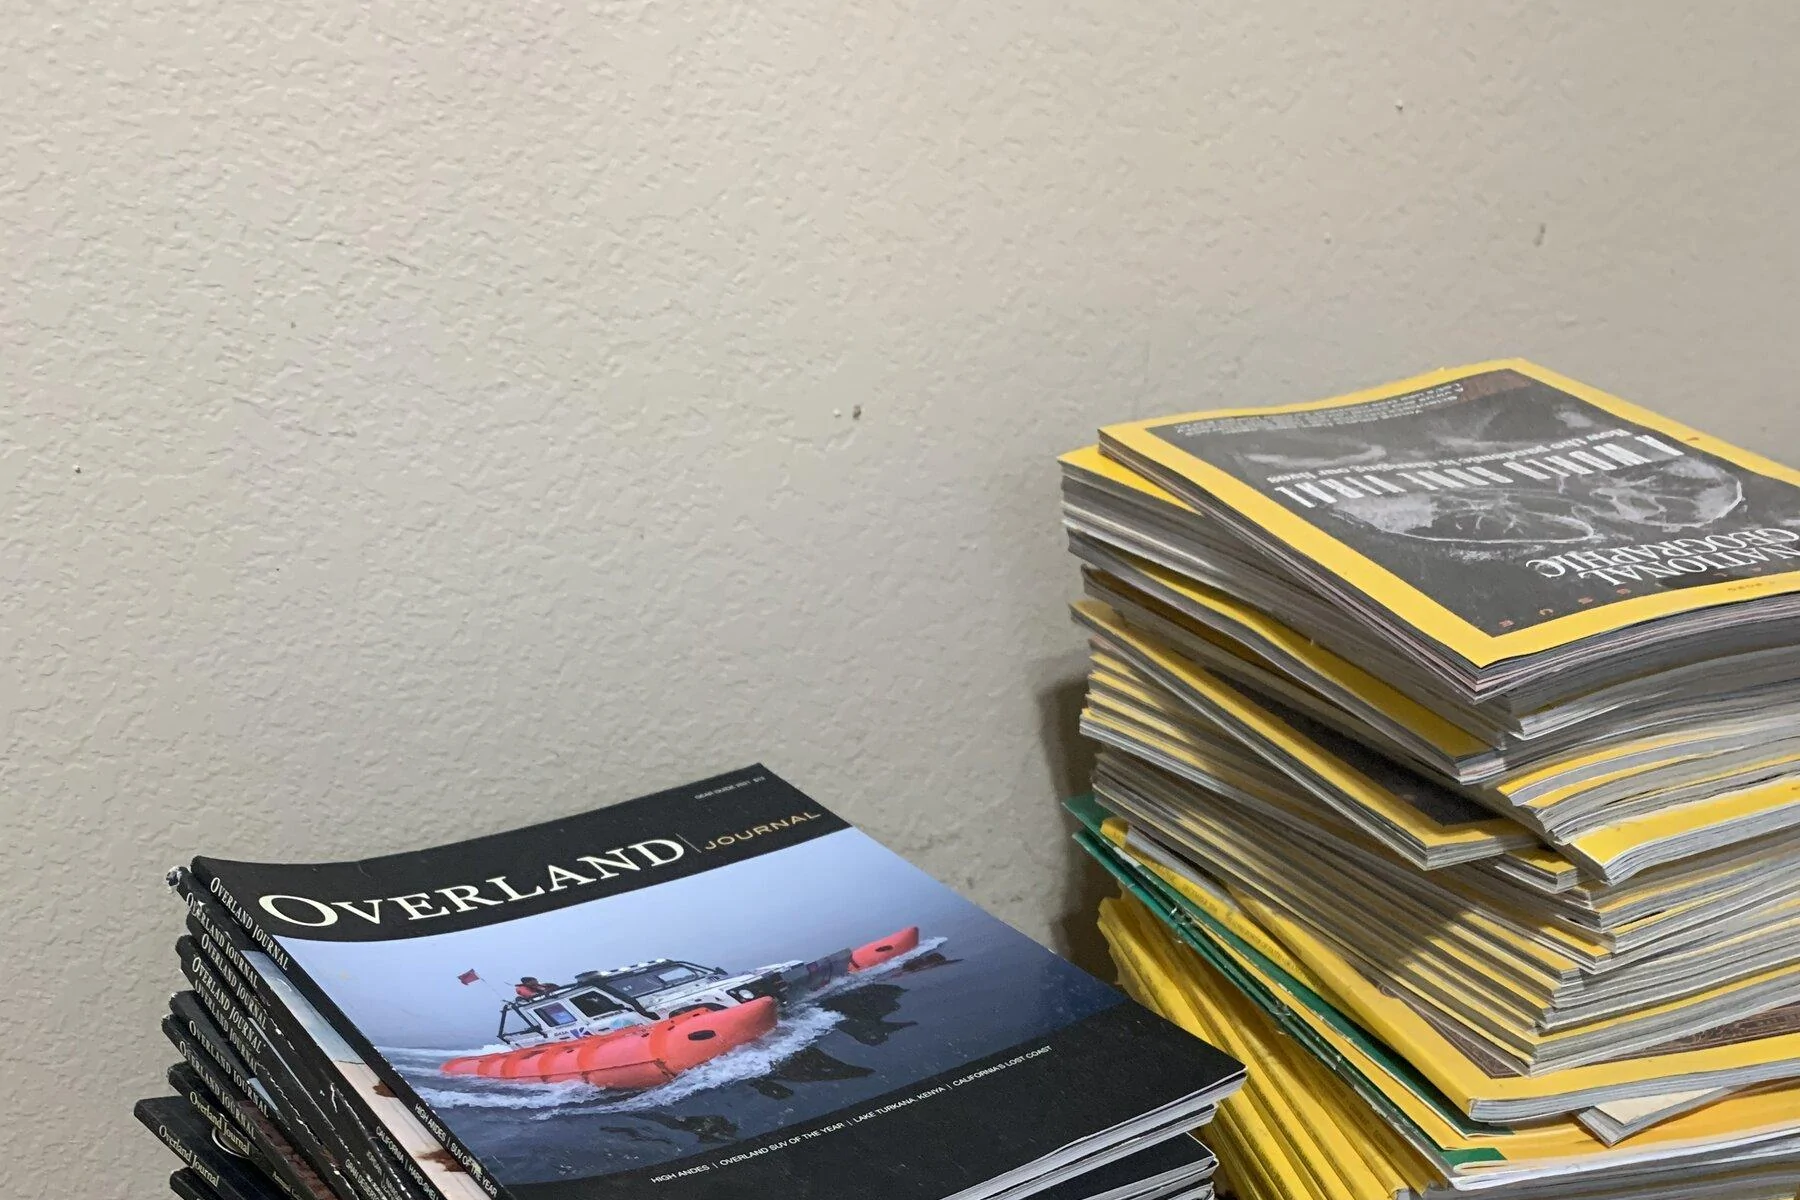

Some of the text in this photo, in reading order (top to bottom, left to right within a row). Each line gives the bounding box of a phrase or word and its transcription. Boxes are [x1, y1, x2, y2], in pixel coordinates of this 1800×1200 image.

[1459, 445, 1550, 466] pandemic
[1503, 442, 1652, 480] WORLD
[1550, 438, 1586, 450] the
[1586, 428, 1632, 442] How
[1275, 474, 1406, 508] VIRAL
[1352, 461, 1438, 474] changing
[1399, 466, 1514, 491] GONE
[1525, 528, 1800, 578] GEOGRAPHIC
[1578, 544, 1800, 586] NATIONAL
[258, 811, 822, 927] OVERLAND JOURNAL
[186, 892, 259, 989] OVERLAND JOURNAL
[210, 876, 289, 971] OVERLAND JOURNAL
[192, 956, 262, 1054] OVERLAND JOURNAL
[201, 932, 268, 1031] OVERLAND JOURNAL
[179, 1040, 257, 1141] OVERLAND JOURNAL
[188, 1020, 269, 1119] OVERLAND JOURNAL
[189, 1091, 251, 1155] Overland Journal
[375, 1125, 404, 1165] CALIFORNIA
[650, 1172, 678, 1184] HIGH
[677, 1164, 711, 1177] ANDES
[719, 1147, 769, 1166] OVERLAND
[768, 1141, 788, 1151] SUV
[788, 1135, 802, 1145] OF
[800, 1129, 821, 1140] THE
[820, 1122, 845, 1134] YEAR
[852, 1111, 877, 1124] LAKE
[916, 1086, 946, 1101] KENYA
[1004, 1055, 1026, 1068] LOST
[1025, 1045, 1053, 1060] COAST
[158, 1124, 220, 1188] Overland Journal
[414, 1103, 429, 1125] HIGH
[428, 1119, 447, 1143] ANDES
[481, 1175, 498, 1199] YEAR
